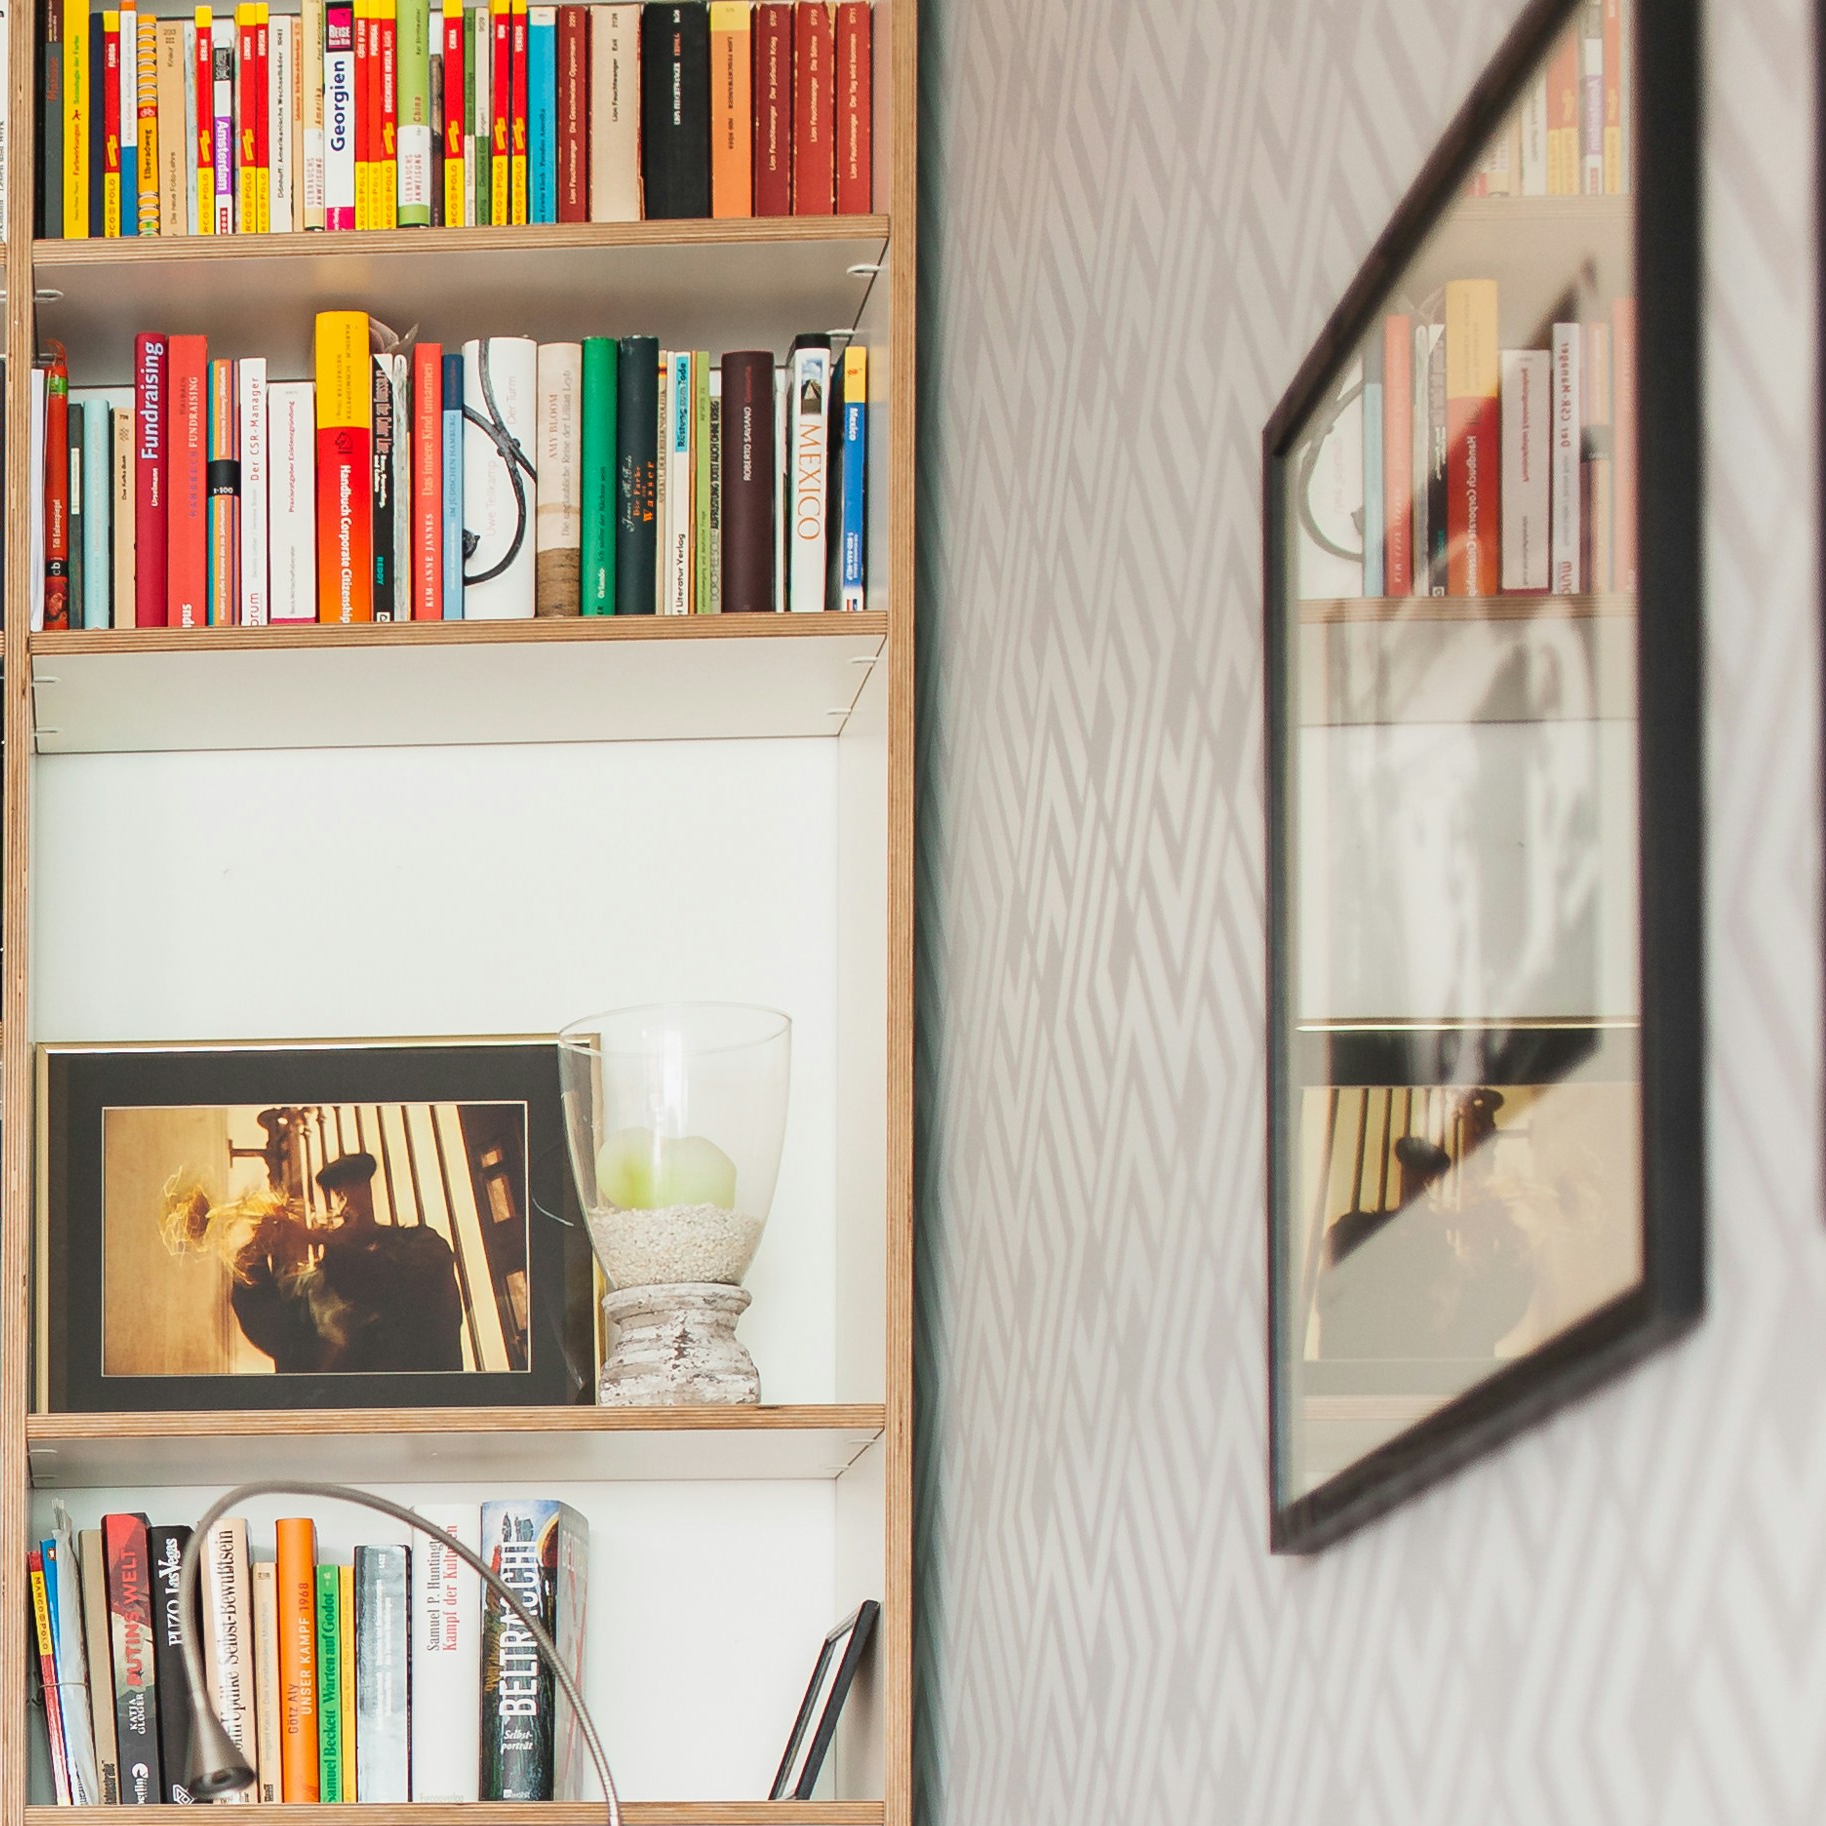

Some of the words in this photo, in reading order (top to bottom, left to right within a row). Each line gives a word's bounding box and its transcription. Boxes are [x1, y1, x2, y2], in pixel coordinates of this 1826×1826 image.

[330, 61, 348, 151] Georgien
[217, 121, 228, 190] Amsterdam
[142, 342, 162, 459] Fundraising
[250, 461, 260, 480] Der
[796, 424, 820, 540] MEXICO
[121, 1550, 137, 1604] WELT
[298, 1583, 310, 1611] 1968
[320, 1592, 335, 1633] Godot
[299, 1617, 311, 1663] KAMPF
[322, 1635, 336, 1655] auf
[287, 1684, 299, 1702] Aly
[300, 1670, 312, 1715] UNSER
[323, 1658, 335, 1703] Warten
[287, 1707, 299, 1734] Götz
[323, 1709, 336, 1755] Beckett
